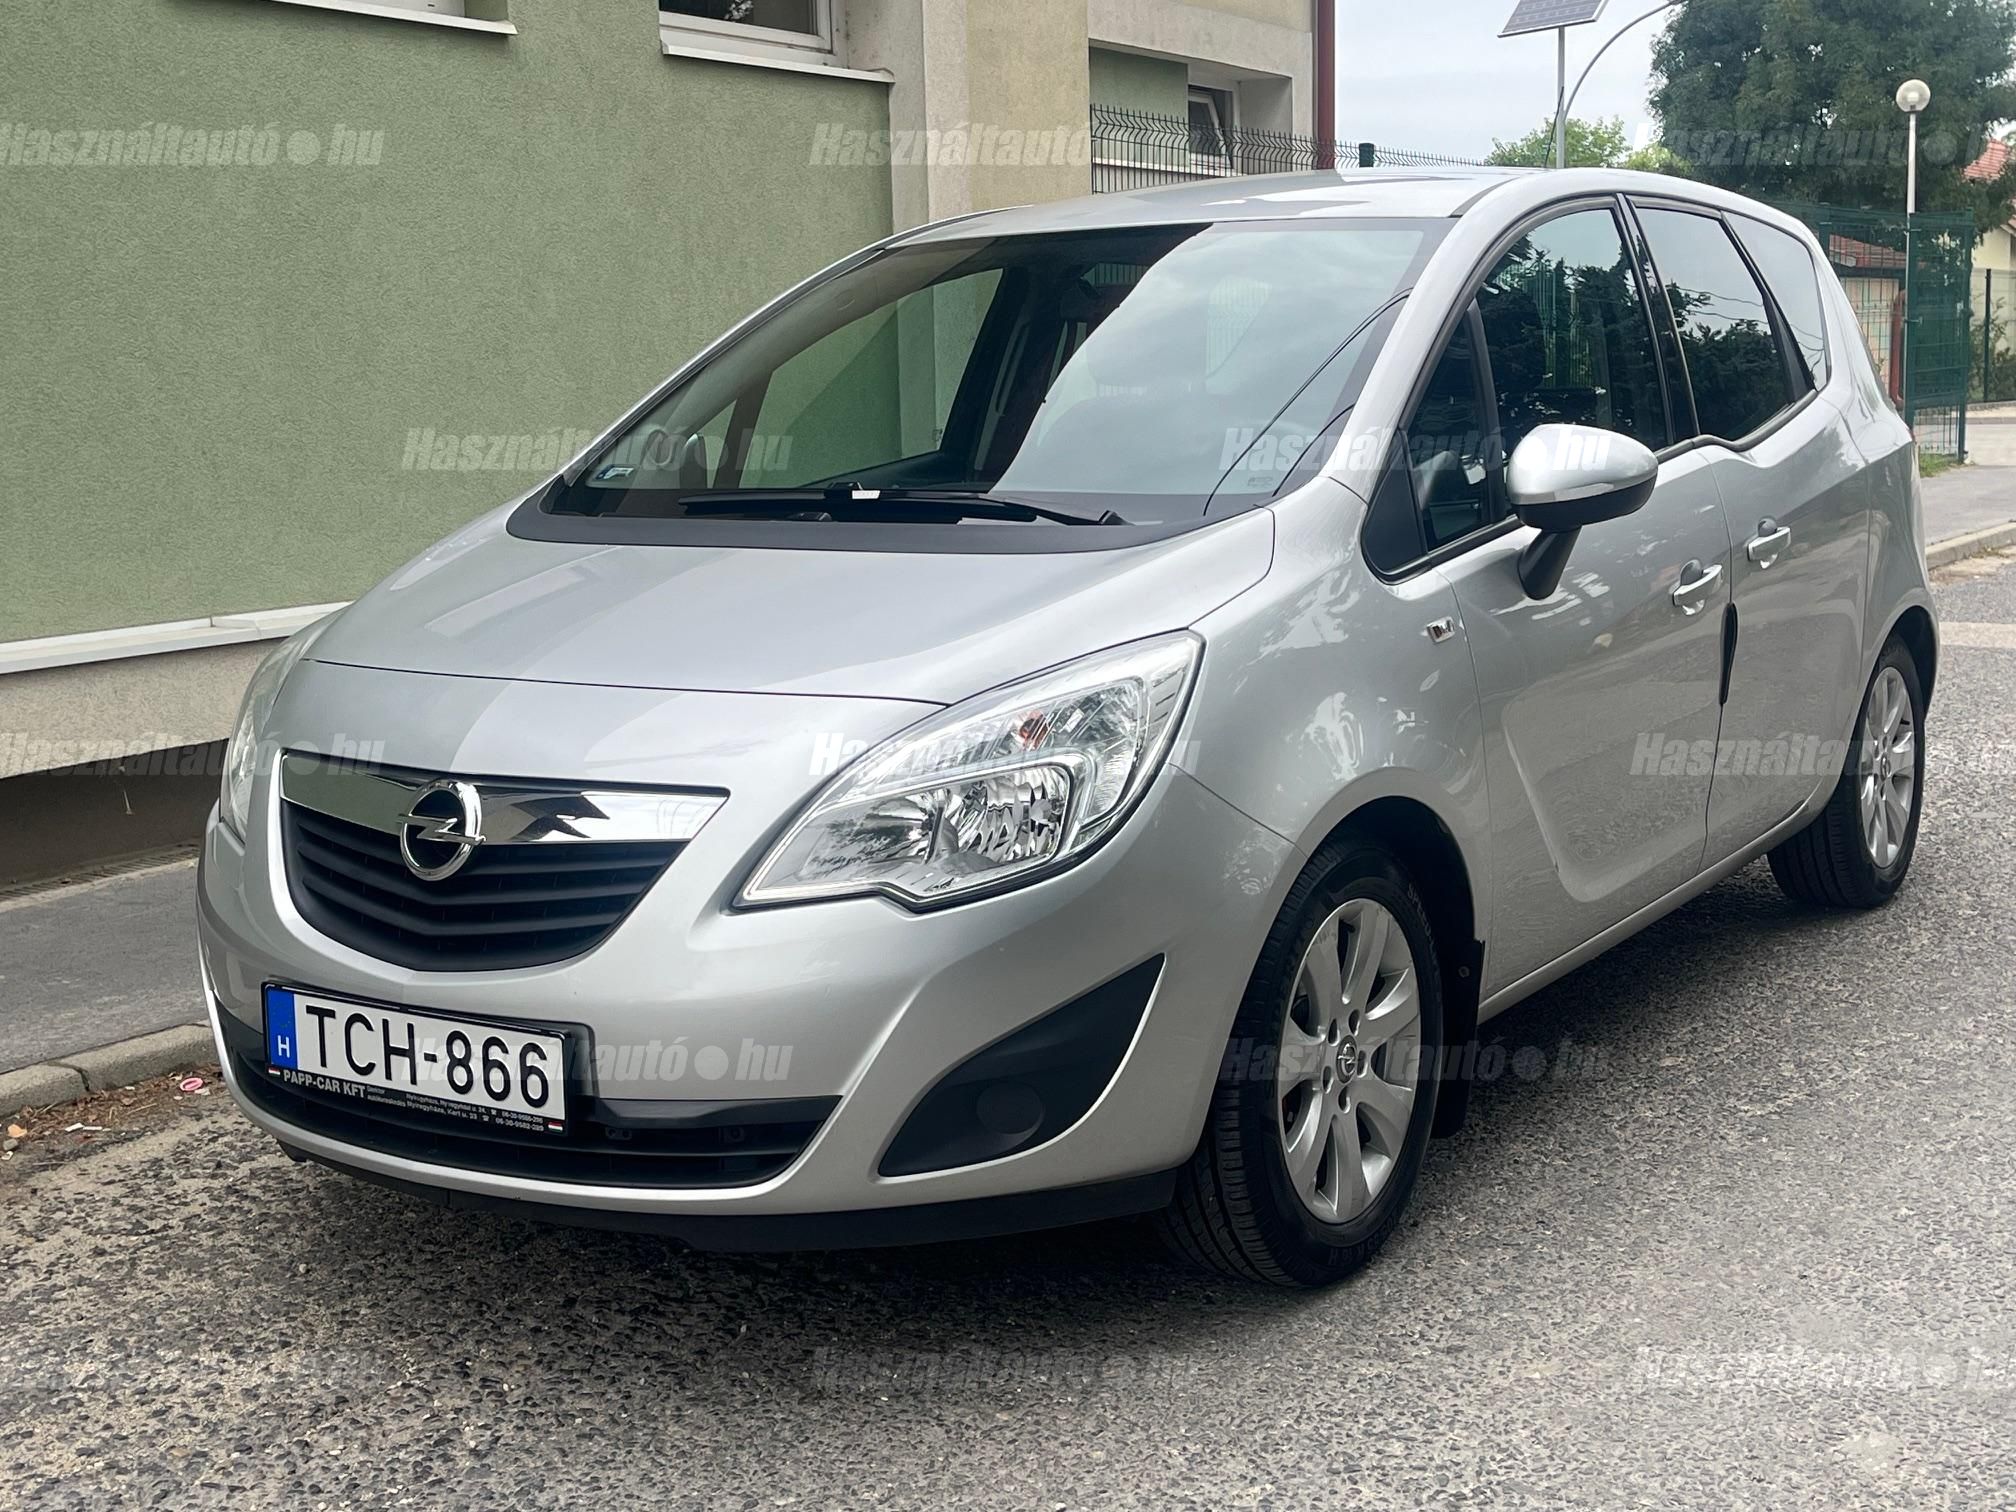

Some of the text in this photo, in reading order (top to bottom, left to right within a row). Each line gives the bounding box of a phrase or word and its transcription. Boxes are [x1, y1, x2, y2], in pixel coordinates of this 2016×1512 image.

[277, 1034, 291, 1059] H
[304, 1004, 550, 1110] TCH-866
[283, 1069, 341, 1093] PAPP-CAR
[343, 1081, 366, 1098] KFT
